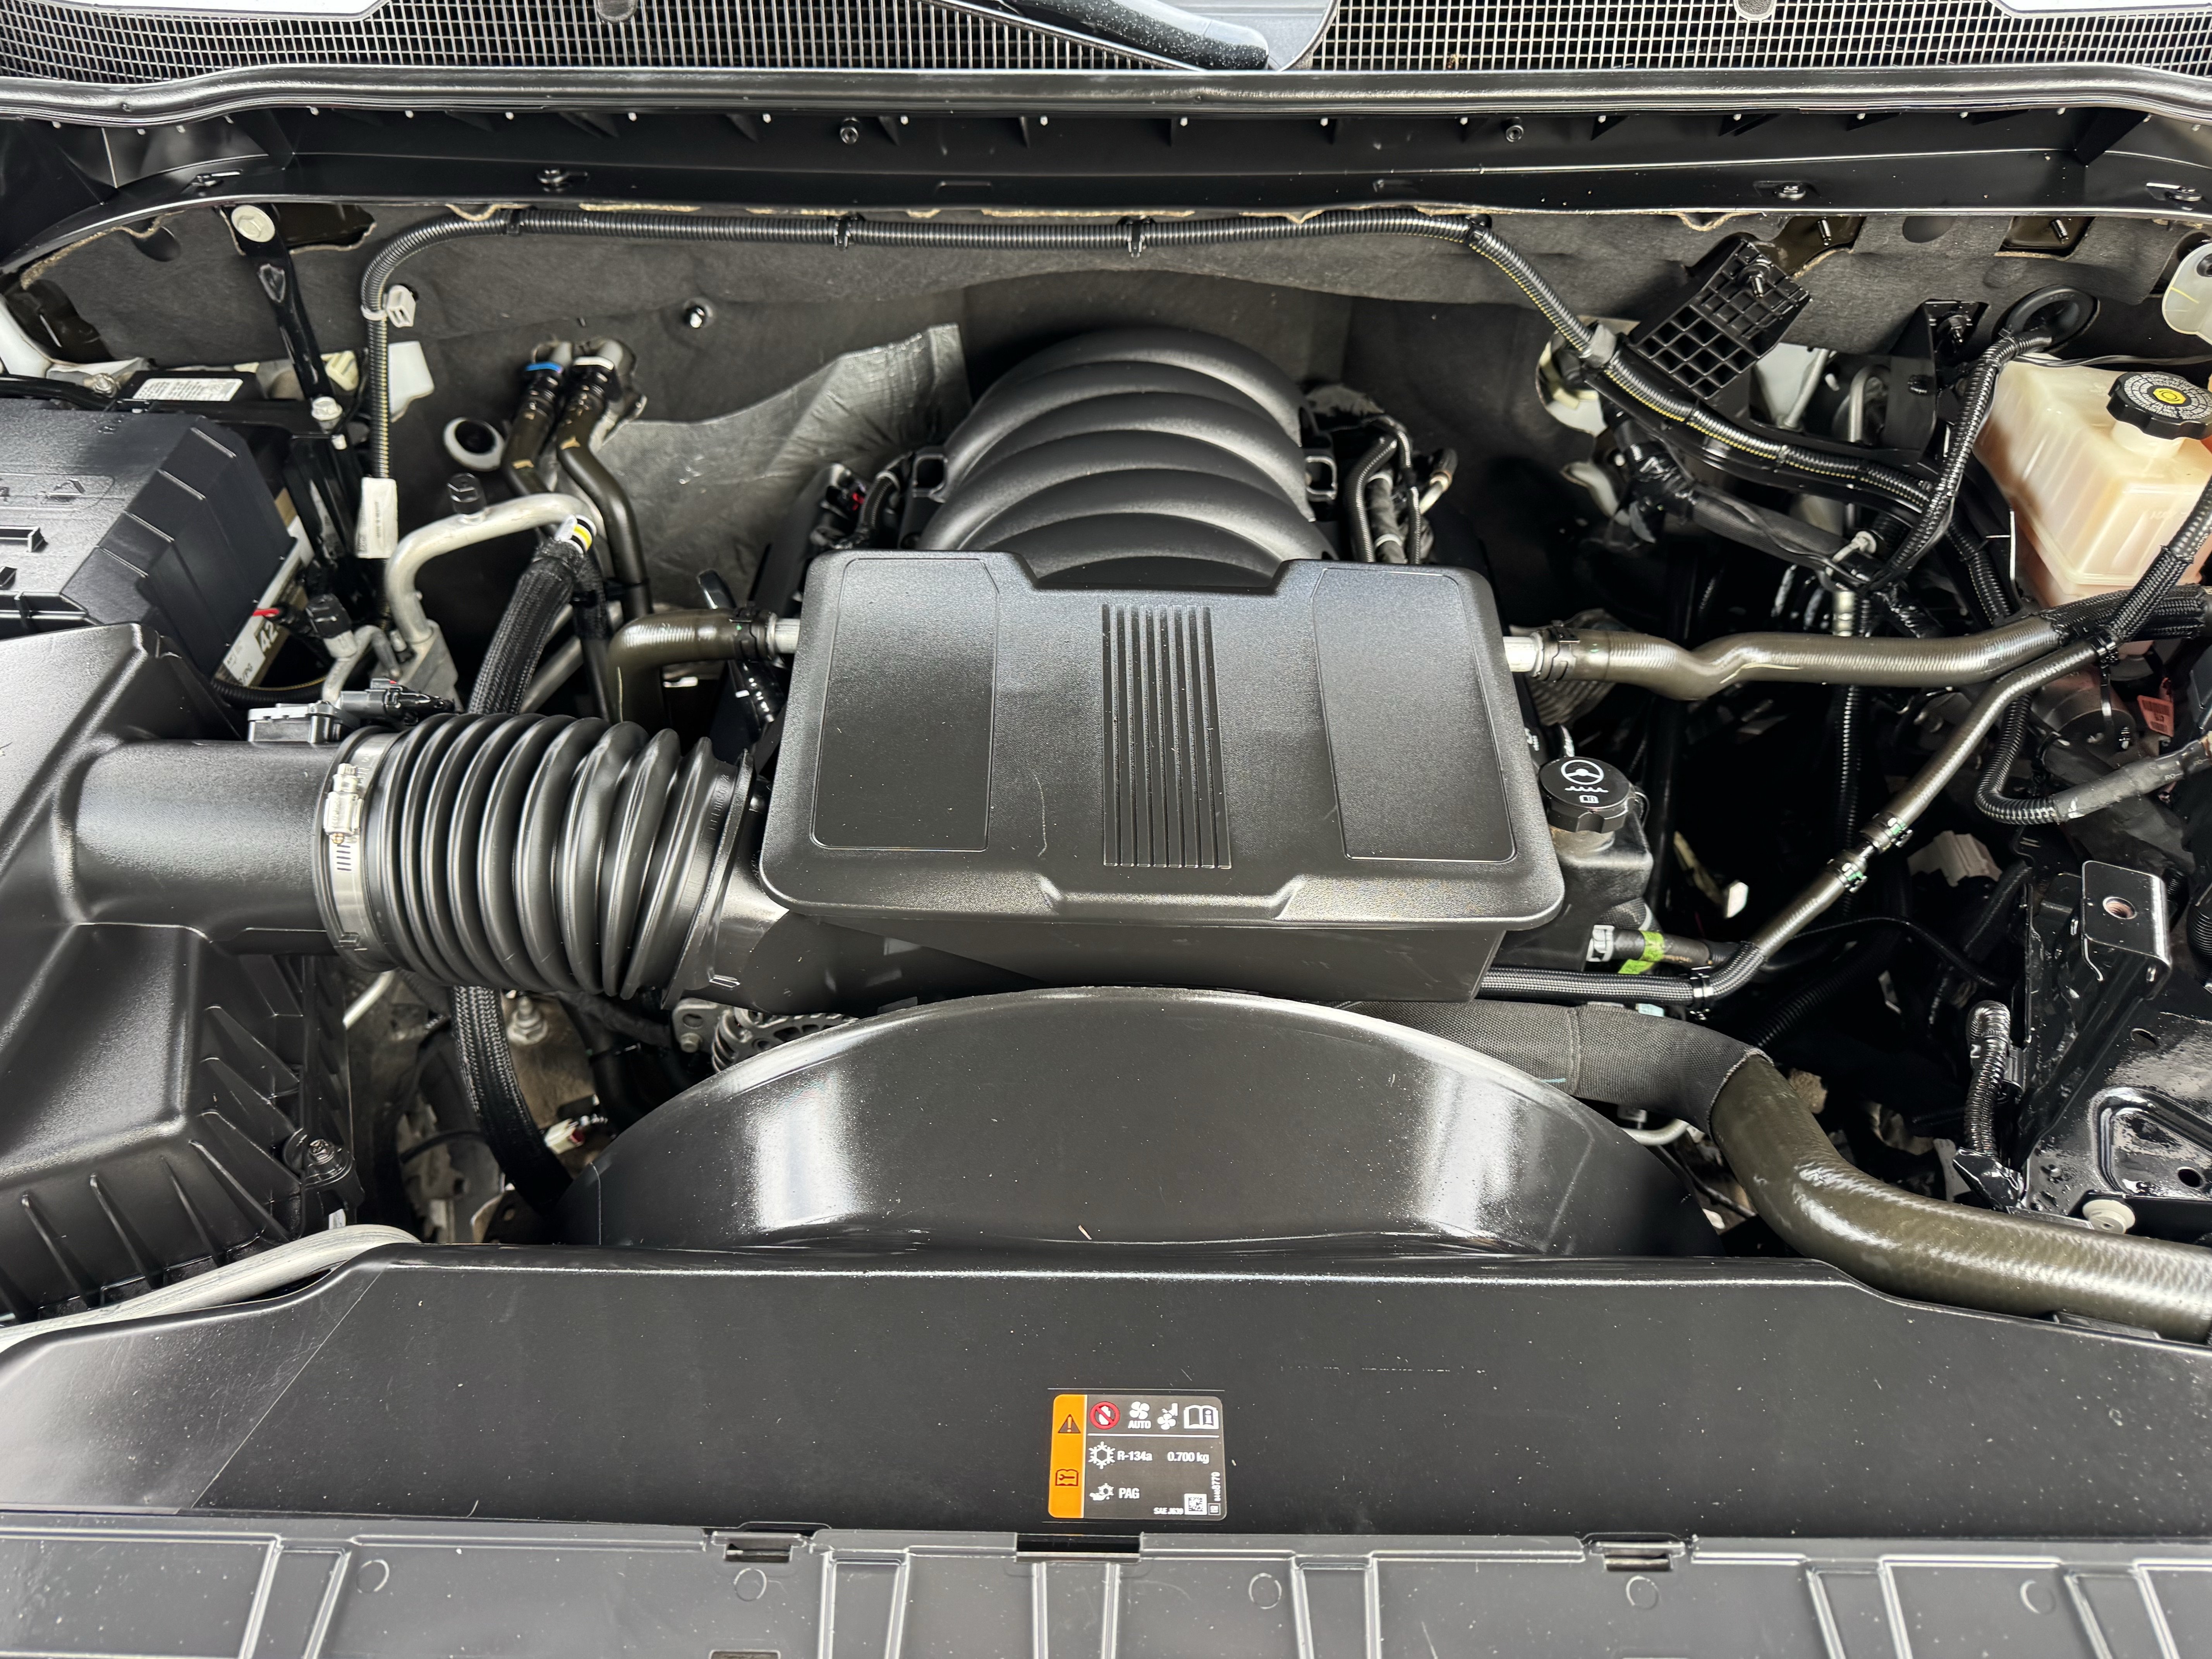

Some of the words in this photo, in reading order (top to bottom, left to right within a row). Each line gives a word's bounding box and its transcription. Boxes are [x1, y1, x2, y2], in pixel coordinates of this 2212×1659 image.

[1128, 1420, 1151, 1429] AUTO
[1117, 1450, 1153, 1461] R-134a
[1167, 1451, 1195, 1462] 0.700
[1196, 1452, 1209, 1464] kg
[1118, 1487, 1140, 1499] PAG
[1153, 1507, 1168, 1515] SAE
